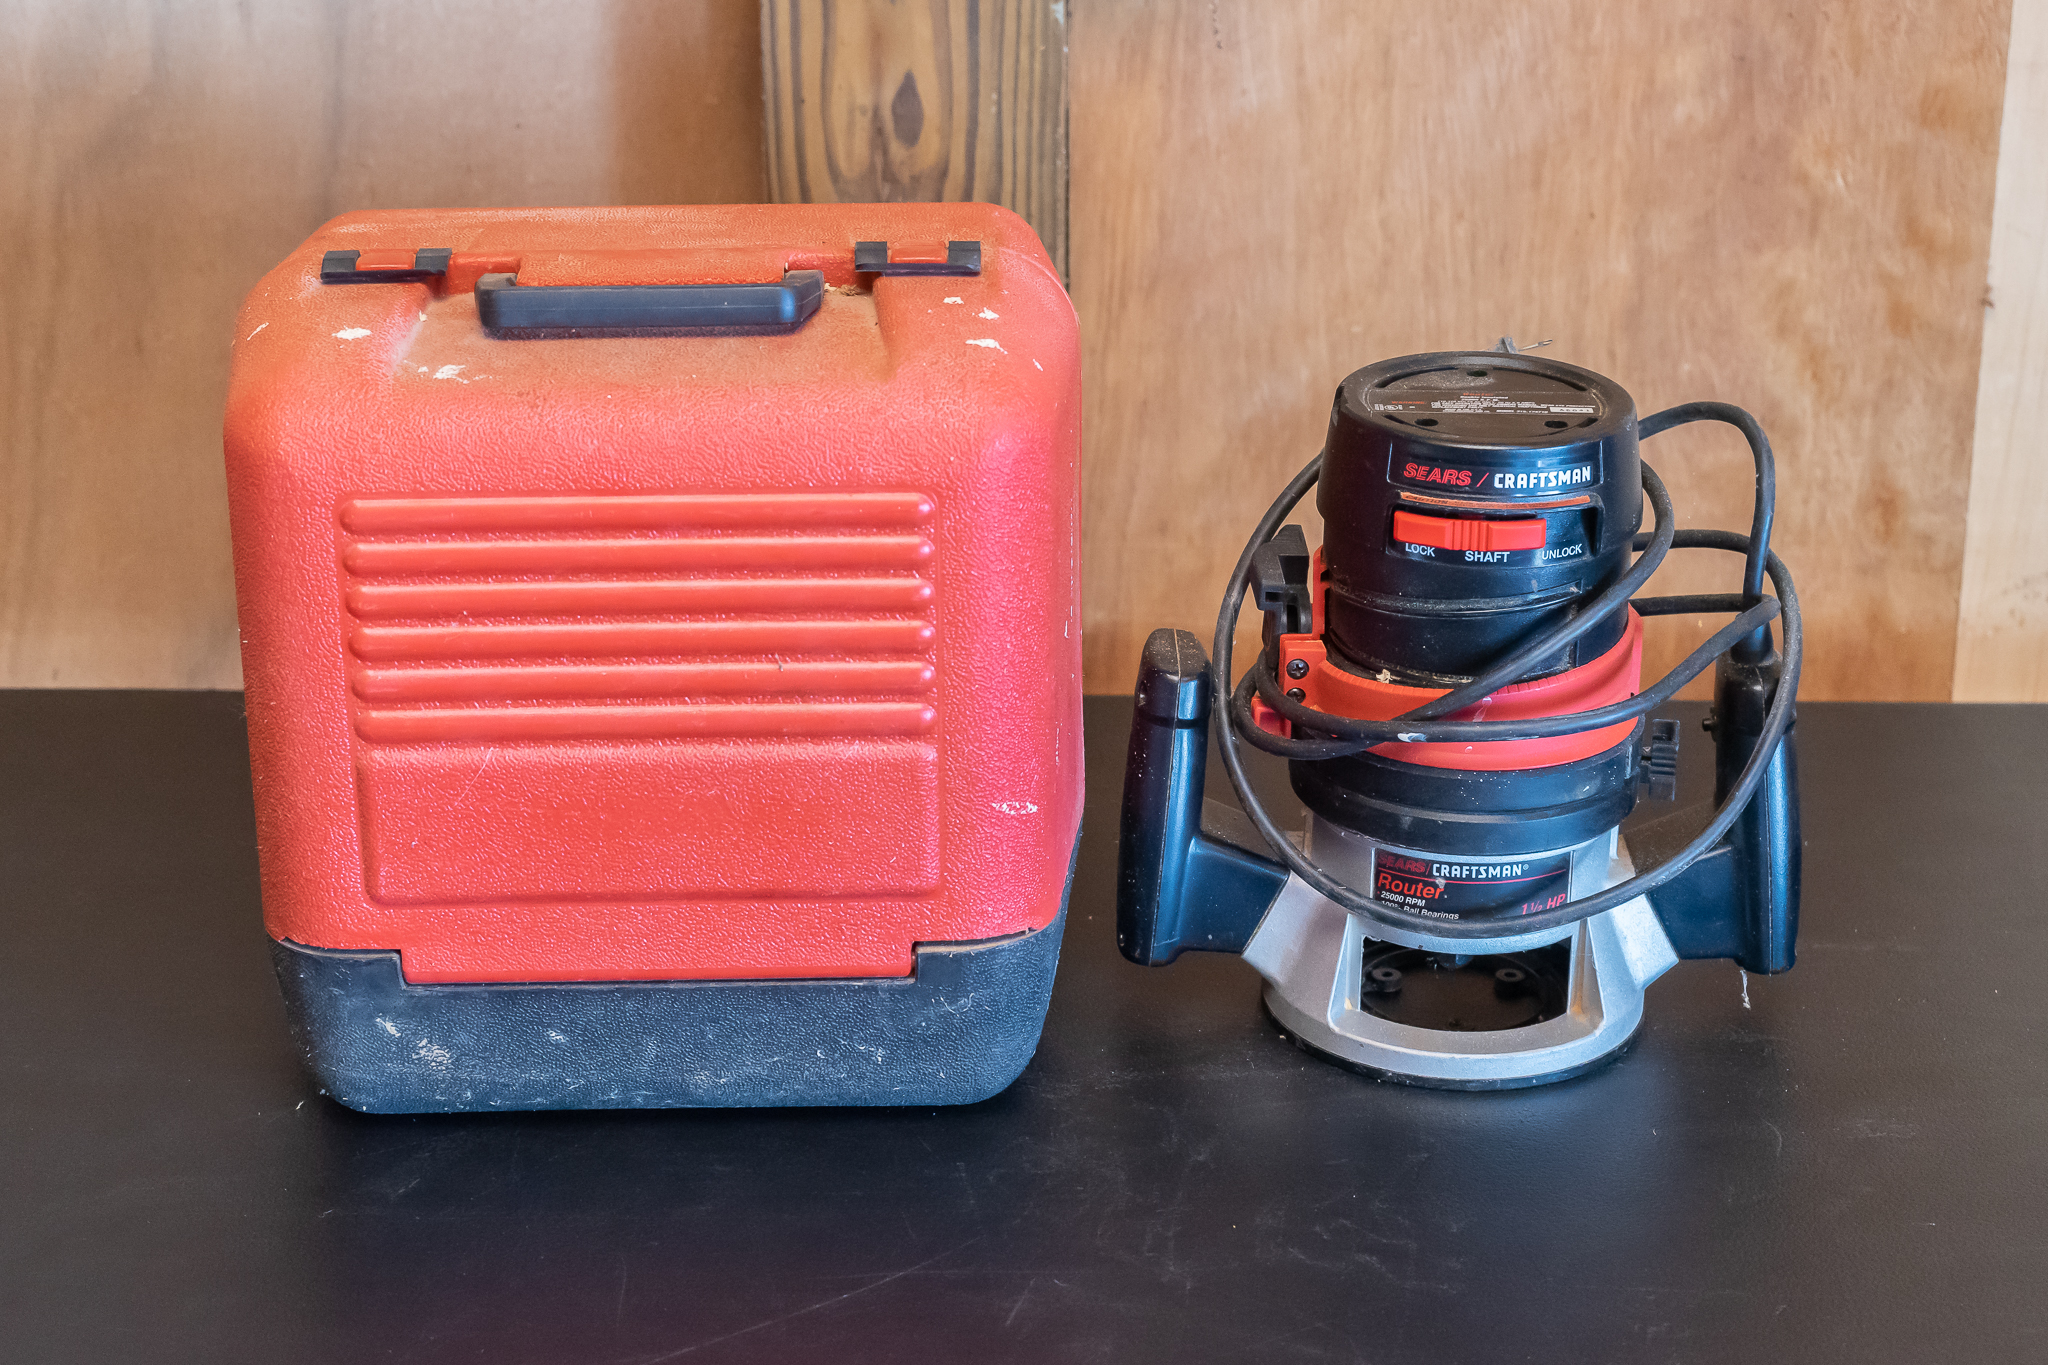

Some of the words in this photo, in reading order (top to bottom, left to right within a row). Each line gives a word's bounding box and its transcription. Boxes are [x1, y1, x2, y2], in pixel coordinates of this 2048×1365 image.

[1403, 462, 1472, 486] SEARS
[1494, 465, 1591, 489] CRAFTSMAN
[1405, 543, 1436, 557] LOCK
[1464, 551, 1510, 562] SHAFT
[1542, 543, 1583, 560] UNLOCK
[1378, 853, 1426, 873] SEARS
[1378, 872, 1445, 900] Router
[1380, 890, 1404, 903] 25000
[1405, 896, 1426, 907] RPM
[1546, 893, 1566, 910] HP
